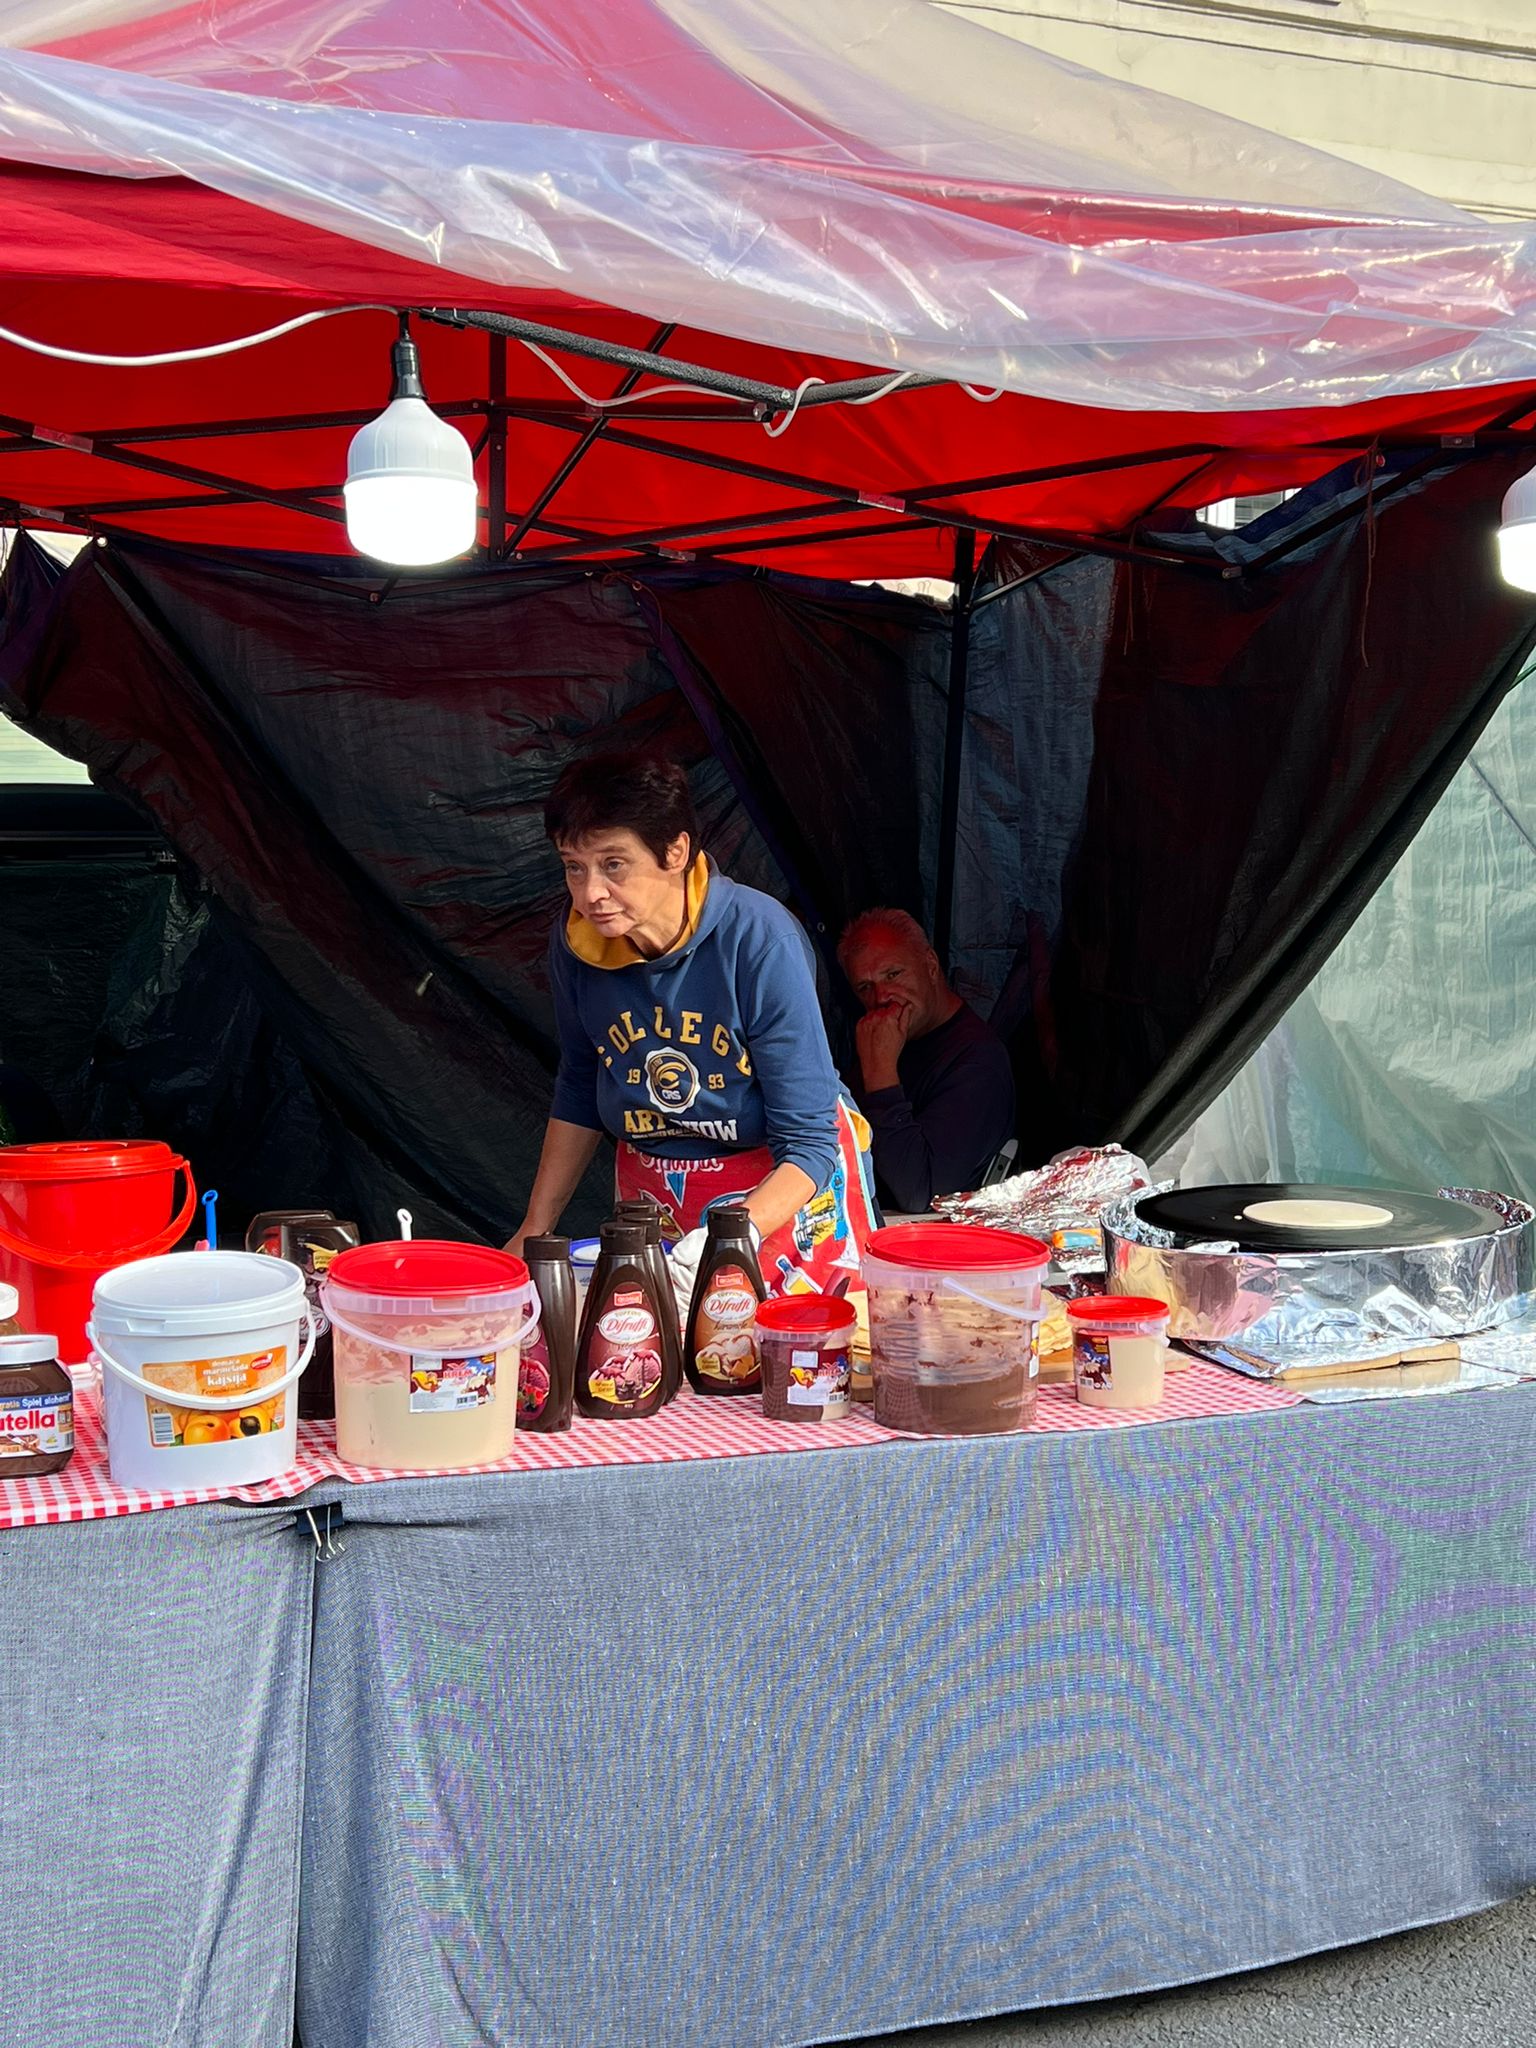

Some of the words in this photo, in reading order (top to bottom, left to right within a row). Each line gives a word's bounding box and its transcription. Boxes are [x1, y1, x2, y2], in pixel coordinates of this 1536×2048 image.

[626, 1068, 641, 1084] 19
[708, 1073, 725, 1089] 93
[624, 1109, 666, 1133] ART
[670, 1118, 738, 1141] HOW
[0, 1409, 55, 1431] tella
